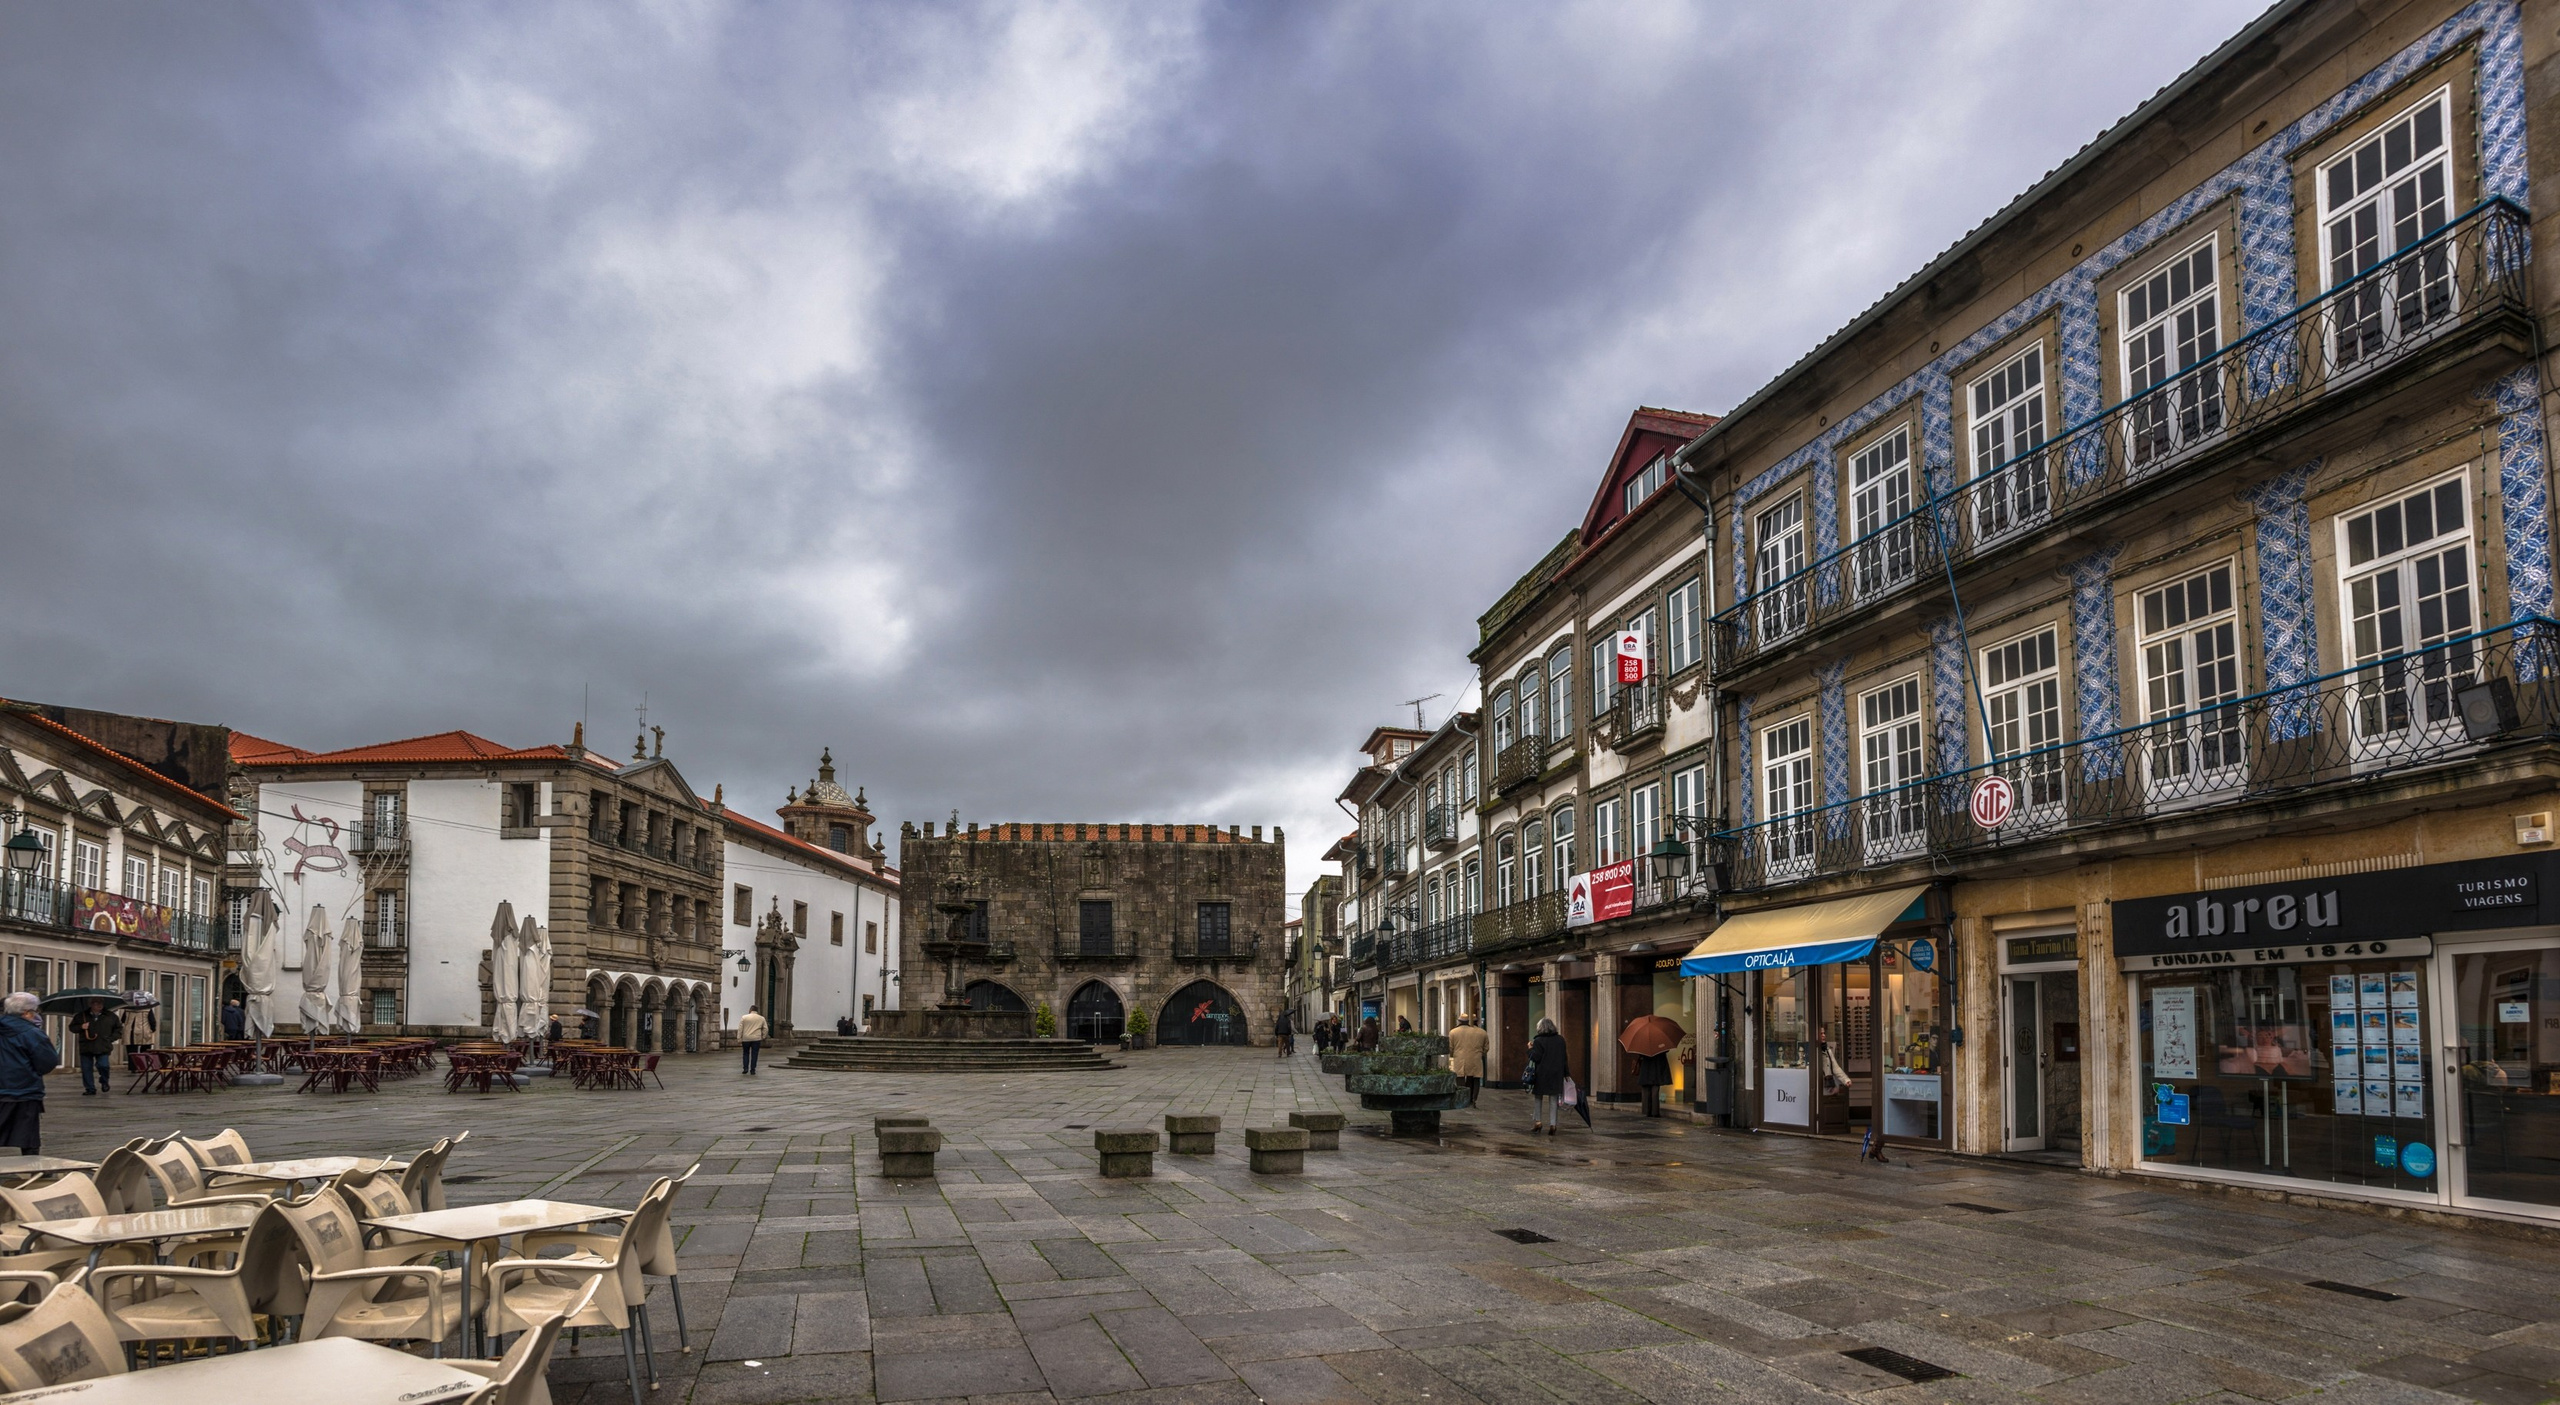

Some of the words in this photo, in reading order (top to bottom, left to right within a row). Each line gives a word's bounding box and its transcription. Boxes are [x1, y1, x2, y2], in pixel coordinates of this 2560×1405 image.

[1592, 871, 1604, 885] 258
[1604, 867, 1618, 881] 800
[2457, 877, 2528, 893] TURISMO
[1573, 901, 1585, 913] ERA
[2465, 893, 2523, 907] VIAGENS
[2165, 890, 2339, 939] abreu
[2030, 938, 2062, 954] Taurino
[2062, 937, 2077, 953] Clu
[2152, 951, 2236, 967] FUNDADA
[2254, 948, 2285, 961] EM
[2304, 941, 2388, 958] 1840
[1655, 958, 1674, 968] ADOLFO
[1776, 1089, 1796, 1103] Dior
